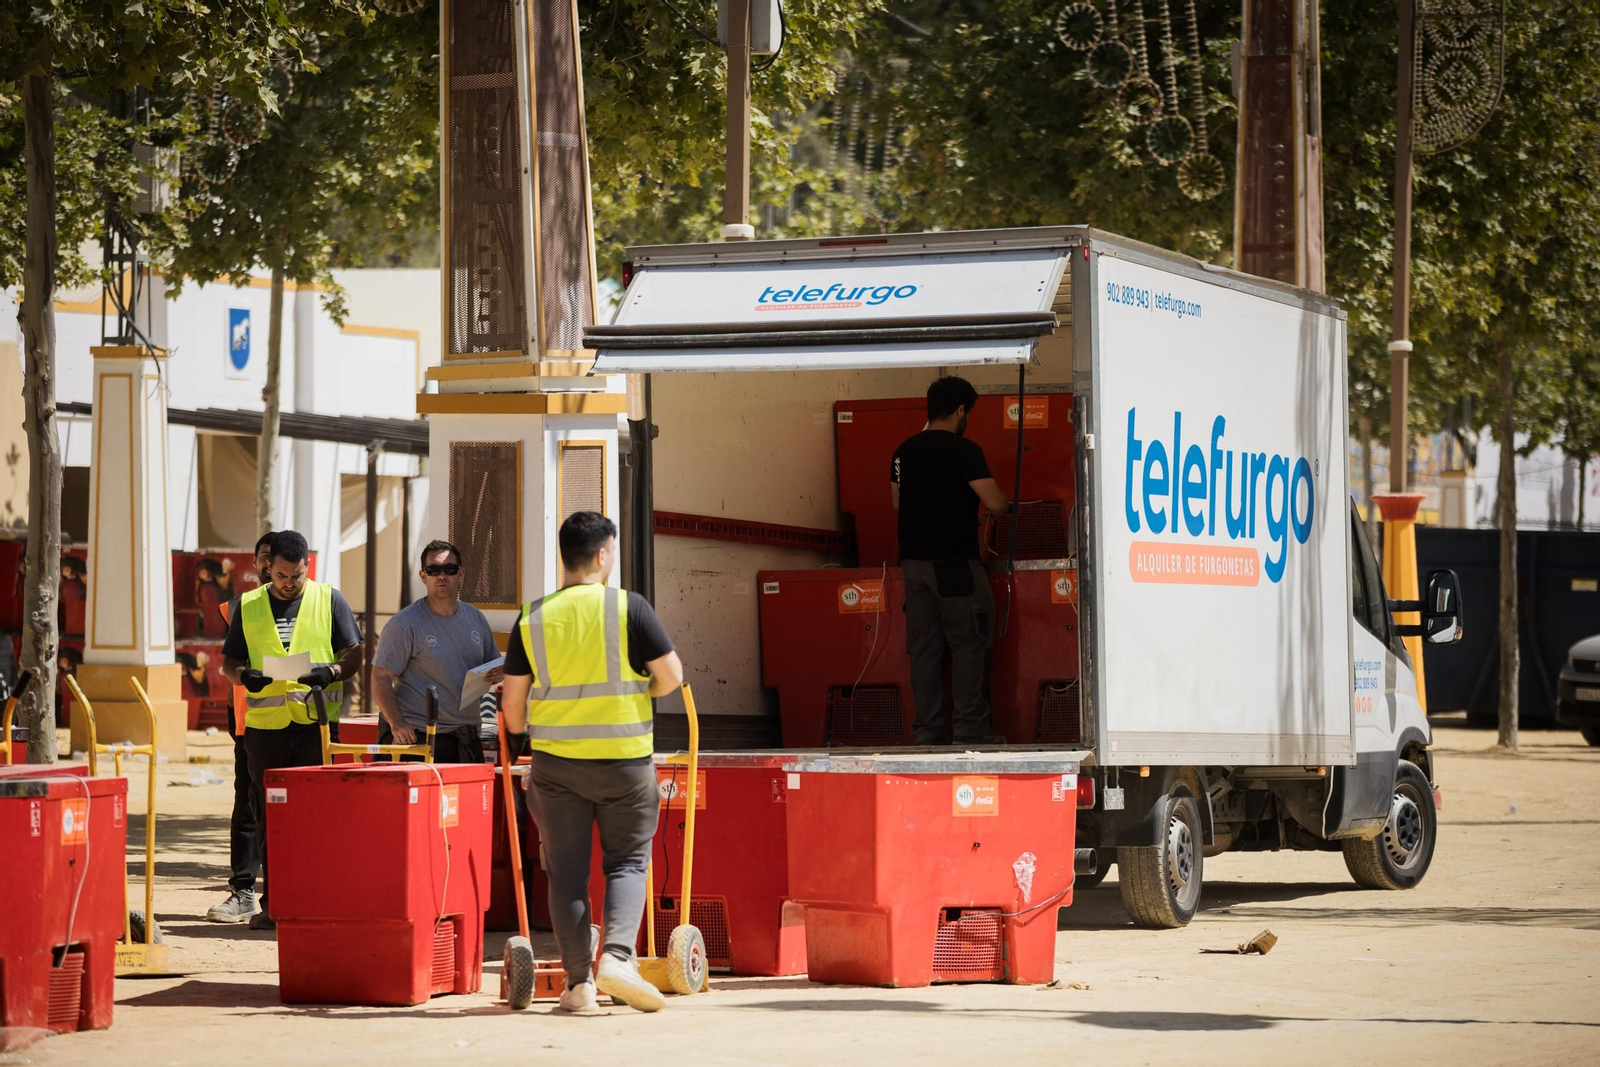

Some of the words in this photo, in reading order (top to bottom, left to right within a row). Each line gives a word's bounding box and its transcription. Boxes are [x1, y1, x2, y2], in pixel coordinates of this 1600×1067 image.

[758, 283, 917, 305] telefurgo
[1107, 282, 1120, 303] 902
[1122, 285, 1135, 306] 889
[1136, 288, 1149, 309] 943
[1155, 291, 1202, 319] telefurgo.com
[1125, 406, 1315, 583] telefurgo
[1137, 552, 1182, 577] ALQUILER
[1185, 555, 1197, 574] DE
[1199, 555, 1254, 577] FURGONETAS
[844, 591, 857, 600] sth
[959, 789, 972, 799] sth
